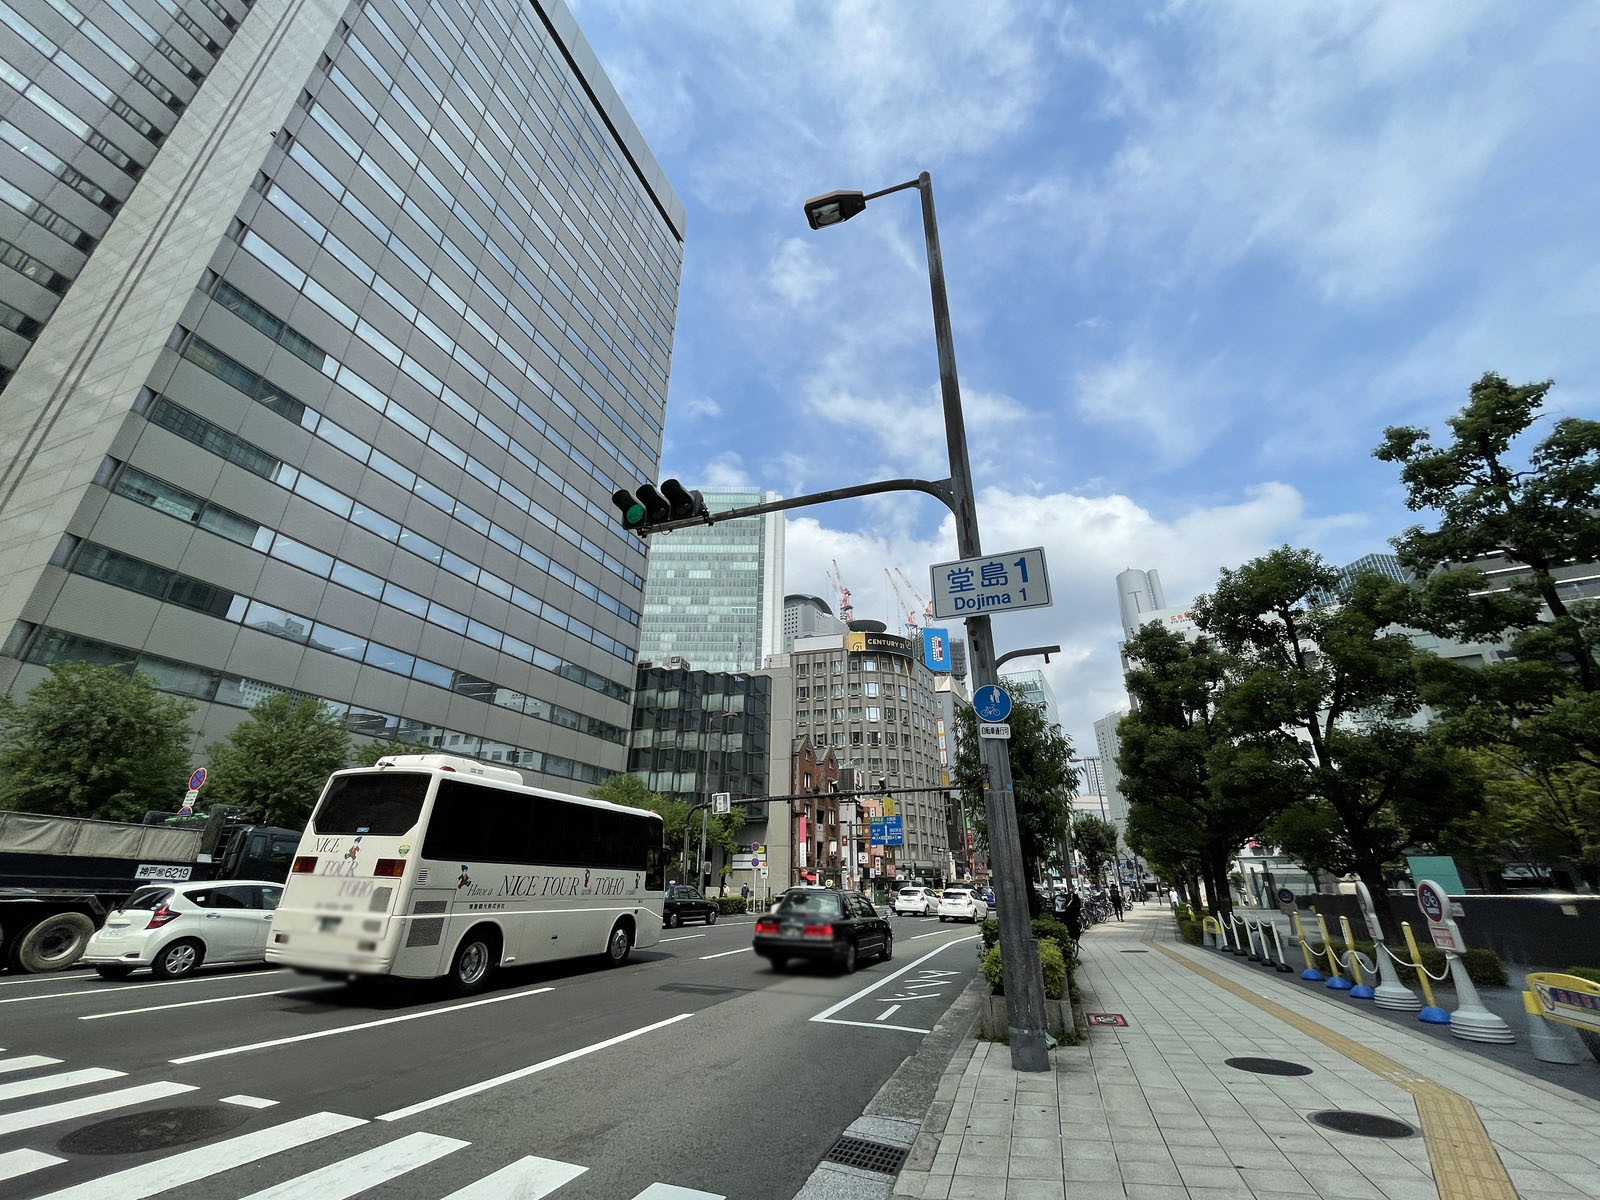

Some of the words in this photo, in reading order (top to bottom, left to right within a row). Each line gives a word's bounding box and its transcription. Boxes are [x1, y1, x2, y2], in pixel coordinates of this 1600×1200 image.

[953, 592, 1012, 611] Dojima
[1019, 587, 1028, 602] 1
[867, 638, 899, 648] CENTURY
[981, 726, 1009, 736] 自転車通行可
[311, 837, 343, 853] NICE
[321, 860, 359, 878] TOUR
[467, 884, 487, 897] Have
[497, 875, 540, 897] NICE
[540, 876, 580, 896] TOUR
